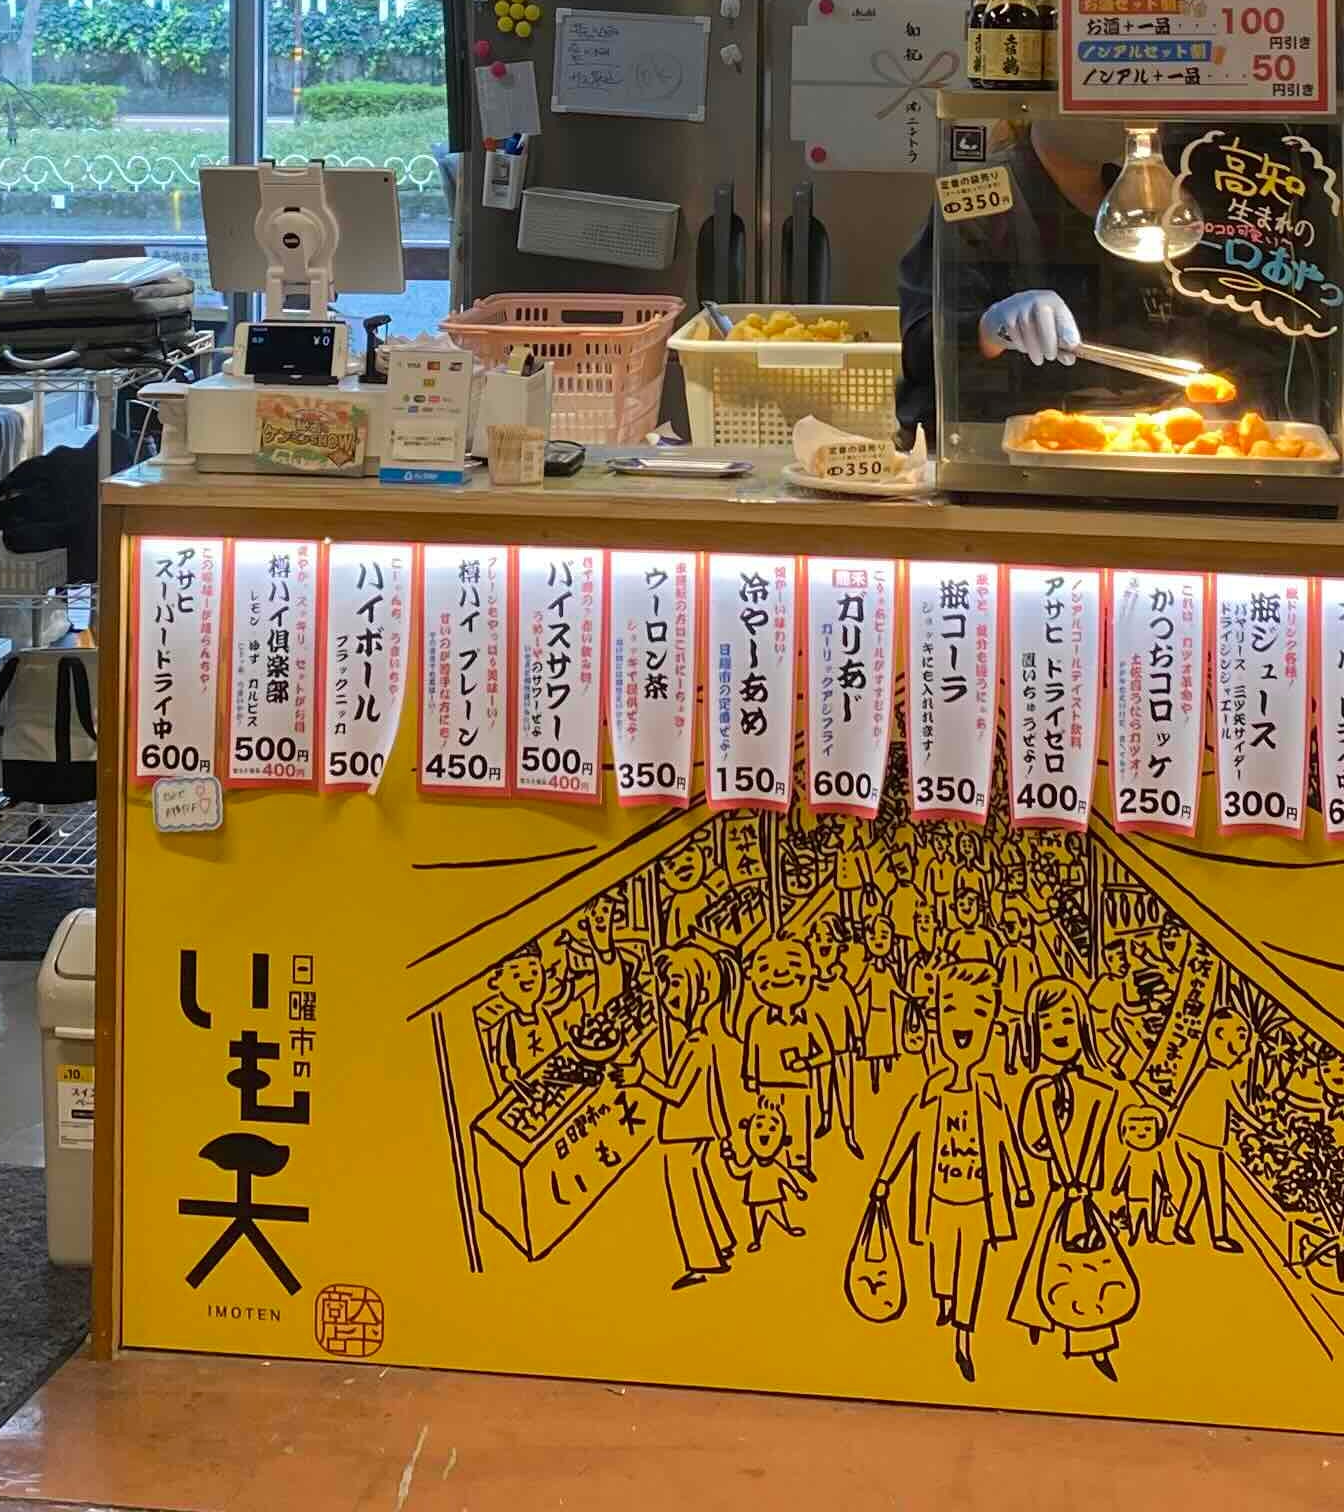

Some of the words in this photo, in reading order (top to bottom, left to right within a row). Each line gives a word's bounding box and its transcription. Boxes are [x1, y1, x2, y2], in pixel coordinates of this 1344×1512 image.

[1220, 6, 1285, 35] 100
[1268, 36, 1312, 51] 円引き
[1251, 54, 1296, 81] 50
[1271, 83, 1315, 98] 円引き
[1214, 137, 1306, 205] 高知
[1227, 198, 1316, 247] 生まれの
[176, 547, 196, 614] アサヒ
[266, 553, 290, 705] 樽ハイ倶楽部
[354, 562, 385, 723] ハイボール
[643, 566, 669, 700] ウーロン茶
[939, 578, 971, 704] 瓶コーラ
[152, 558, 175, 740] スーパードライ中
[546, 561, 574, 742] バイスサワー
[836, 590, 867, 724] ガリあじ
[1147, 587, 1175, 779] かつおコロッケ
[1249, 591, 1282, 750] 瓶ジュース
[141, 743, 211, 772] 600円
[234, 736, 310, 763] 500円
[521, 746, 594, 777] 500円
[425, 752, 502, 781] 450円
[618, 762, 687, 791] 350円
[715, 766, 786, 797] 150円
[813, 770, 879, 801] 600円
[915, 776, 985, 808] 350円
[1016, 782, 1087, 815] 400円
[1119, 787, 1193, 820] 250円
[1223, 790, 1298, 823] 300円
[287, 954, 317, 1079] 日曜市の
[207, 1304, 282, 1322] IMOTEN
